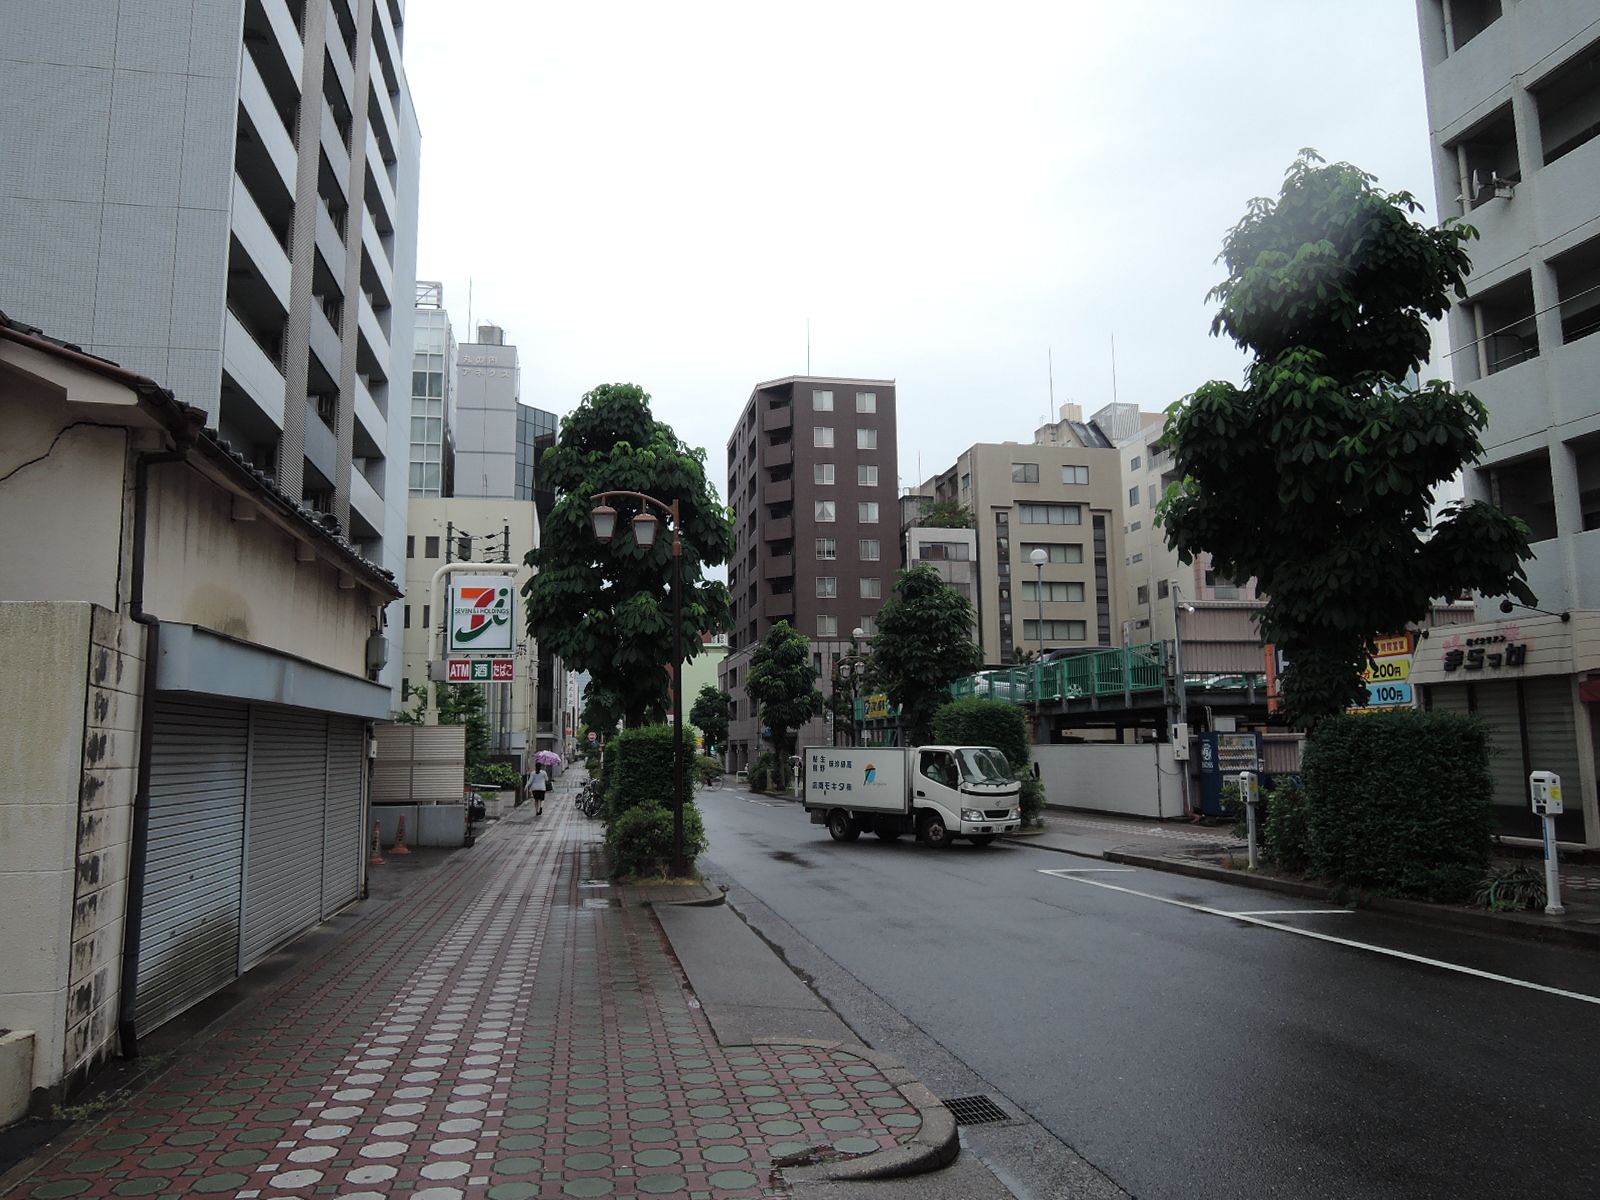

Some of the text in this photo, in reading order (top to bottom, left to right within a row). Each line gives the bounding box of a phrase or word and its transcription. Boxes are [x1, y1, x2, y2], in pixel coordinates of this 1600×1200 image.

[450, 664, 469, 678] ATM
[474, 664, 488, 678] 酒
[493, 664, 513, 677] たばこ
[1376, 686, 1404, 702] 100円
